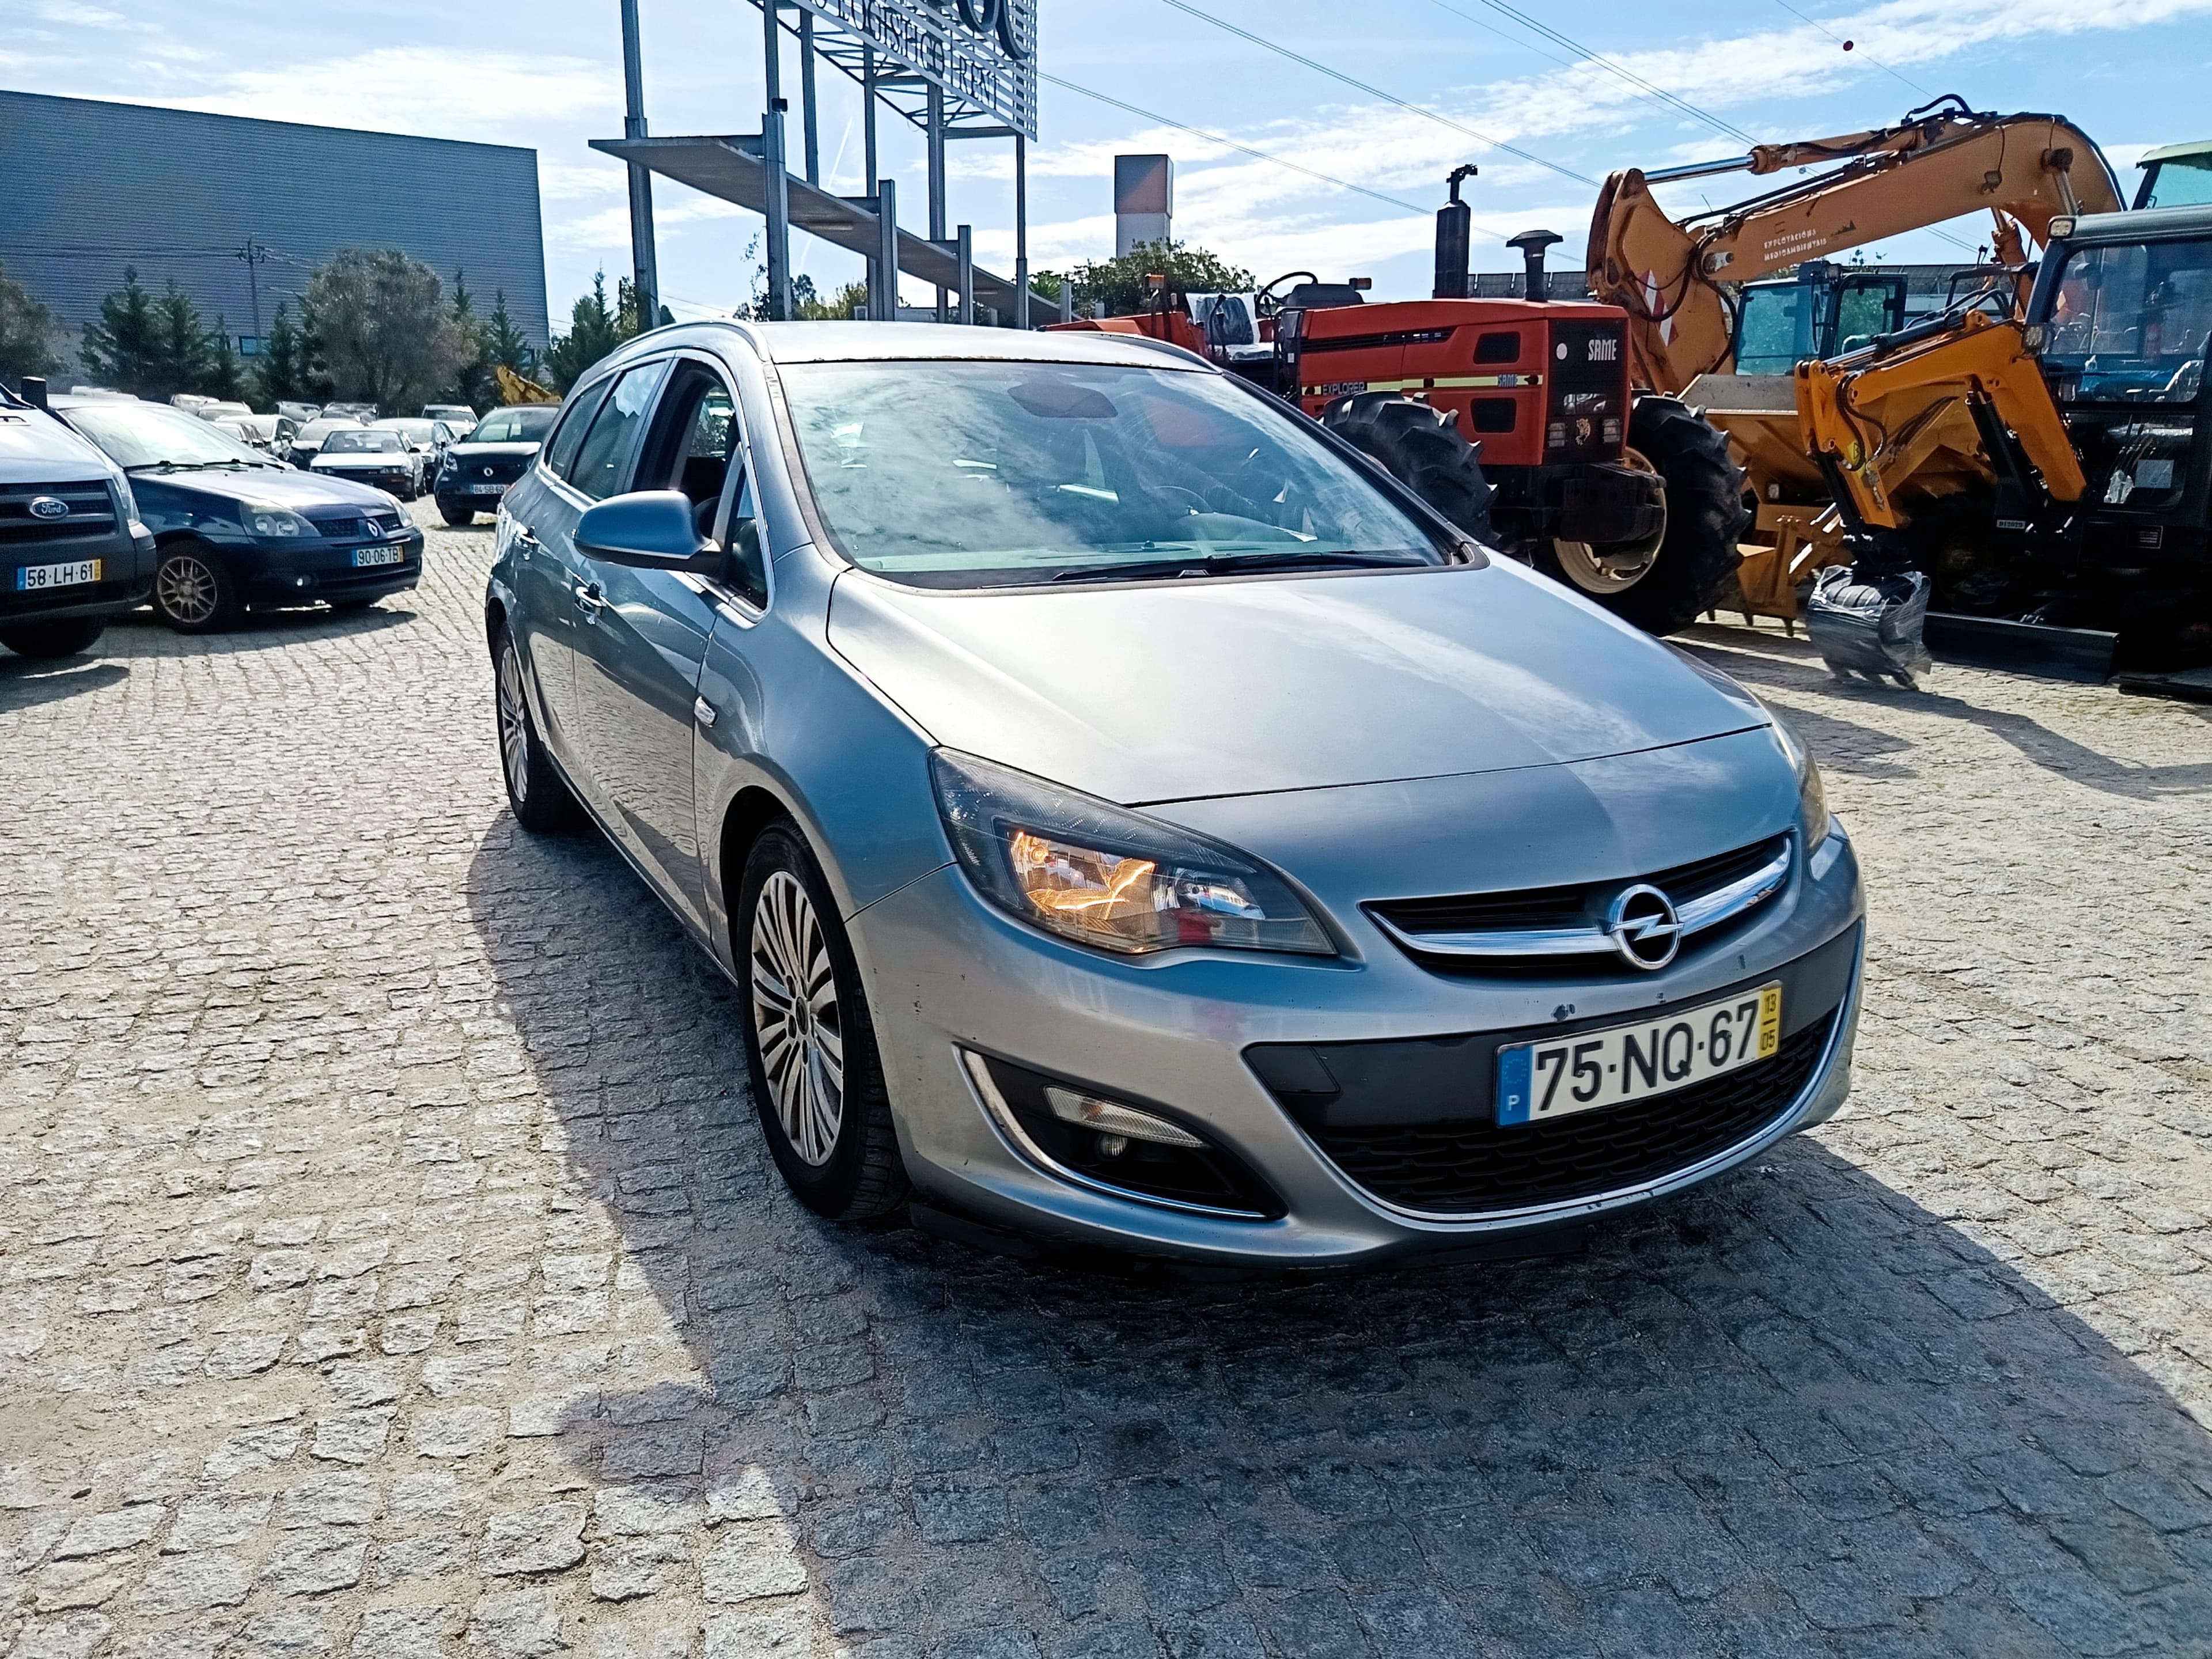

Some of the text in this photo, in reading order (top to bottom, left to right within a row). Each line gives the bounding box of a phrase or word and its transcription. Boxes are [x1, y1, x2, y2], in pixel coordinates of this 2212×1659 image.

[1588, 339, 1617, 361] SAME
[1323, 381, 1365, 396] EXPLORER
[1498, 374, 1518, 388] SAME
[41, 503, 62, 514] Ford
[1764, 993, 1777, 1014] 13
[1760, 1029, 1775, 1051] 05
[1509, 1096, 1520, 1111] P
